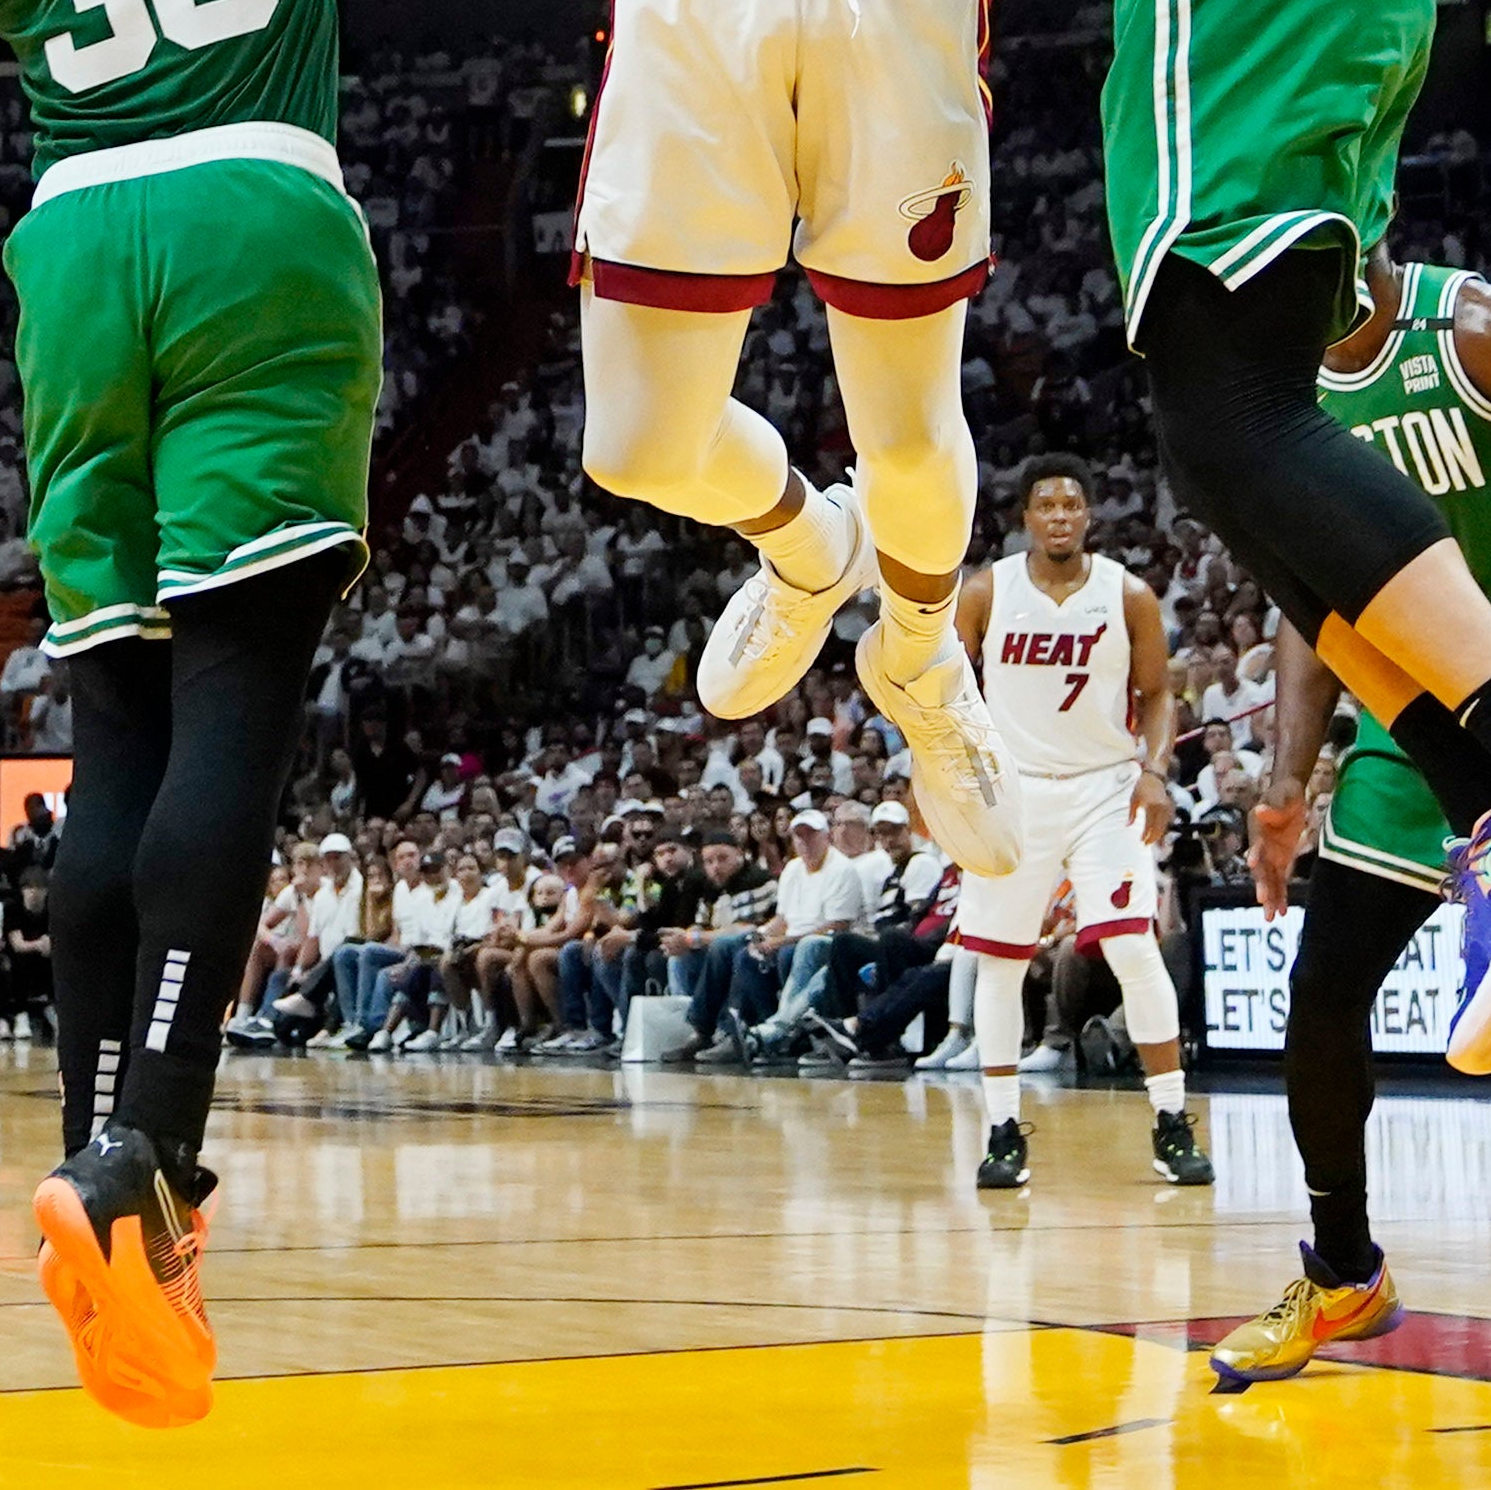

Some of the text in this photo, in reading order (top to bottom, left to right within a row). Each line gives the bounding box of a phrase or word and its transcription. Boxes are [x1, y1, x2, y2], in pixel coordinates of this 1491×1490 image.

[1399, 353, 1439, 381] VISTA
[1402, 372, 1441, 396] PRINT
[1000, 620, 1108, 667] HEAT
[1057, 673, 1090, 712] 7
